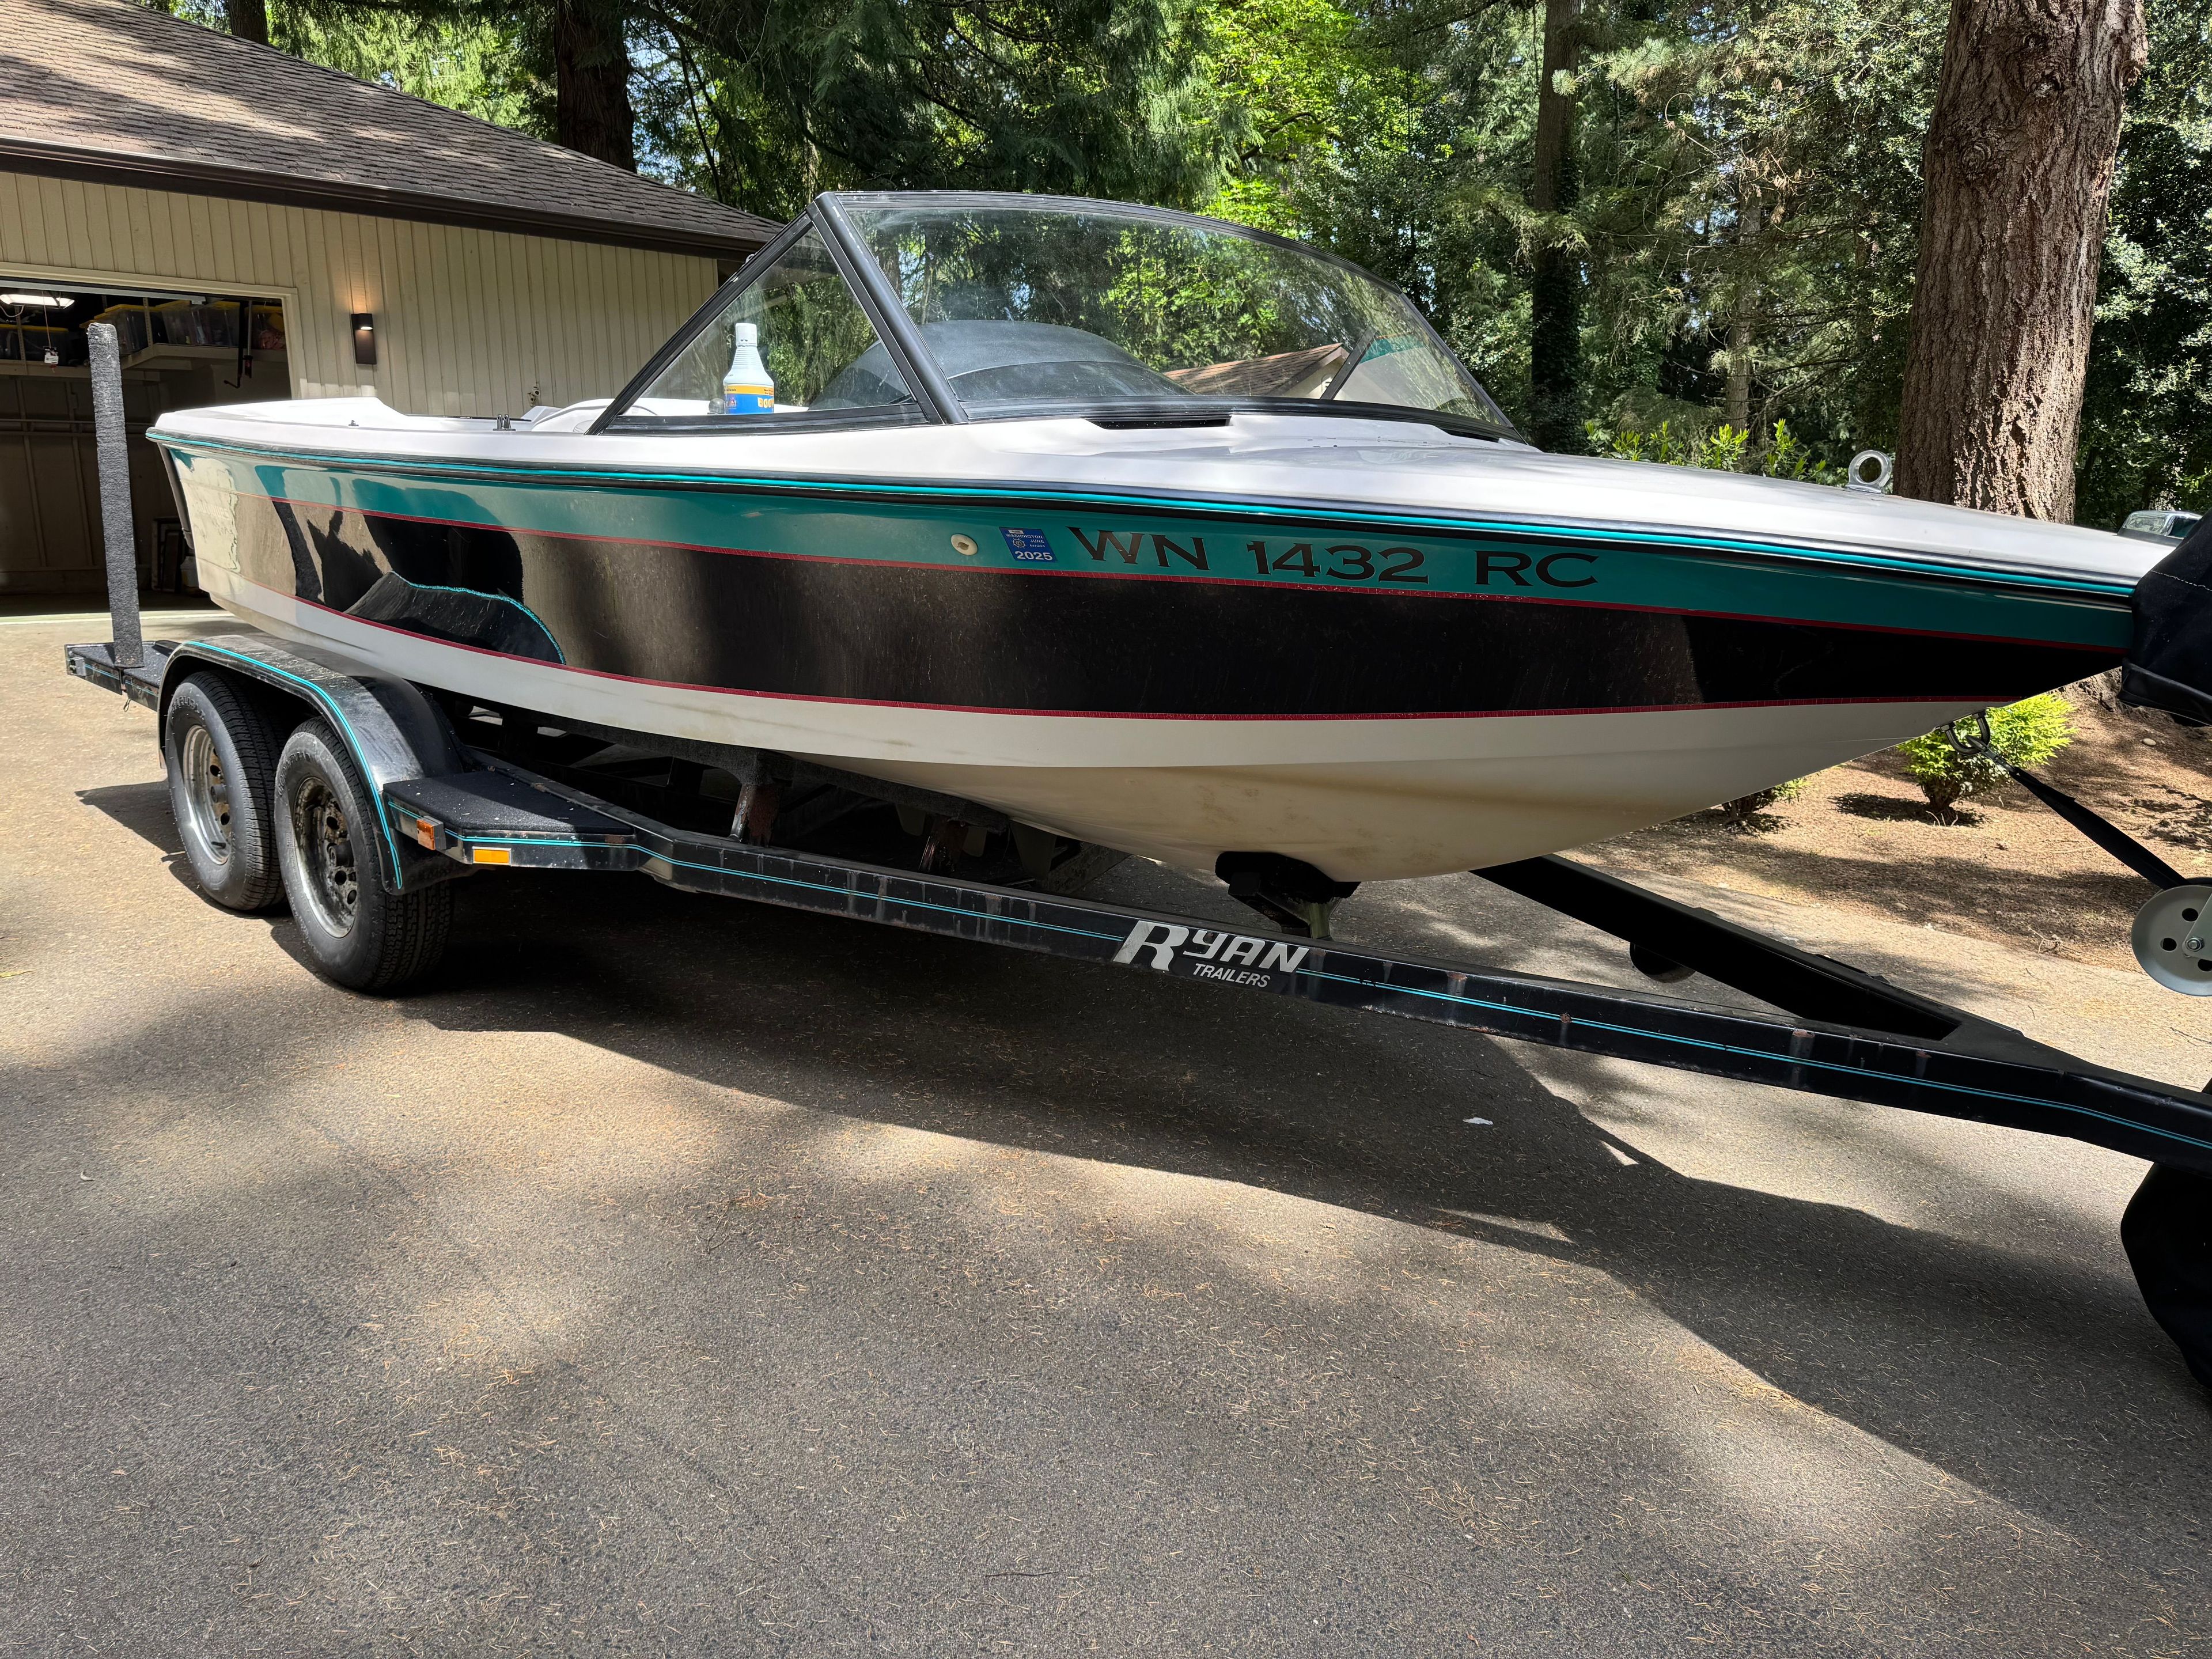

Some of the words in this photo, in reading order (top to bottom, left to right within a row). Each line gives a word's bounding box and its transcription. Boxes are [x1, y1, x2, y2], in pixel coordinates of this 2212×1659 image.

[1015, 551, 1053, 560] 2025
[1066, 527, 1210, 570] WN
[1246, 540, 1429, 584] 1432
[1475, 550, 1599, 588] RC
[1112, 921, 1310, 973] RYAN
[1192, 963, 1271, 988] TRAILERS
